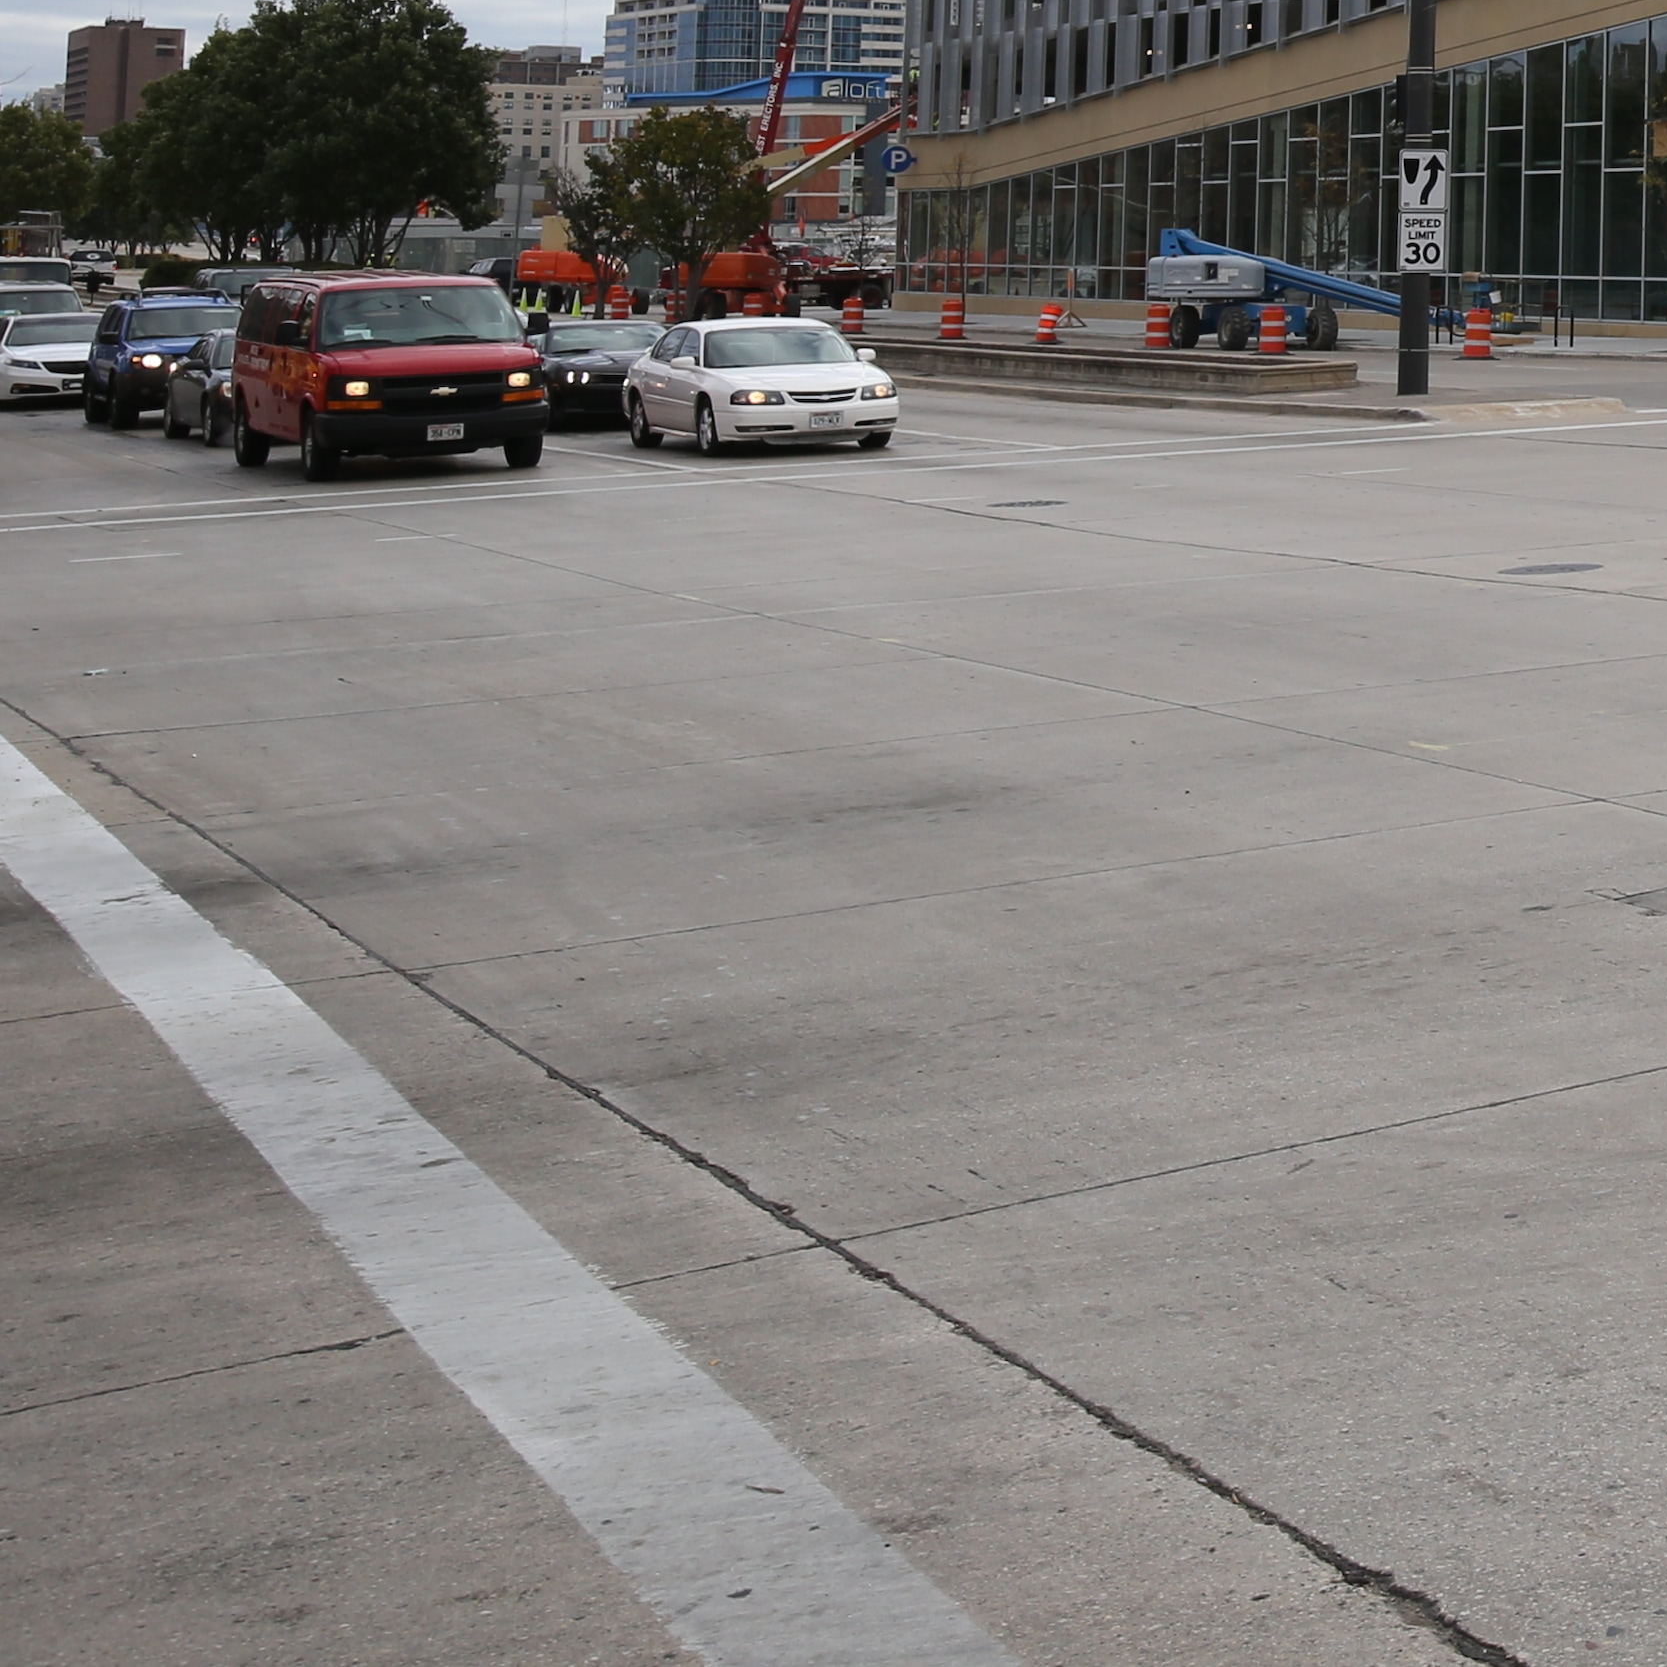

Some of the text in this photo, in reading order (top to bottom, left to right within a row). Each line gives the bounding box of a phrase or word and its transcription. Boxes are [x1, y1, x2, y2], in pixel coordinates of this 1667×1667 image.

[822, 78, 882, 98] aloft
[890, 150, 907, 170] P
[1404, 218, 1441, 228] SPEED
[1408, 231, 1436, 240] LIMIT
[1404, 242, 1440, 264] 30
